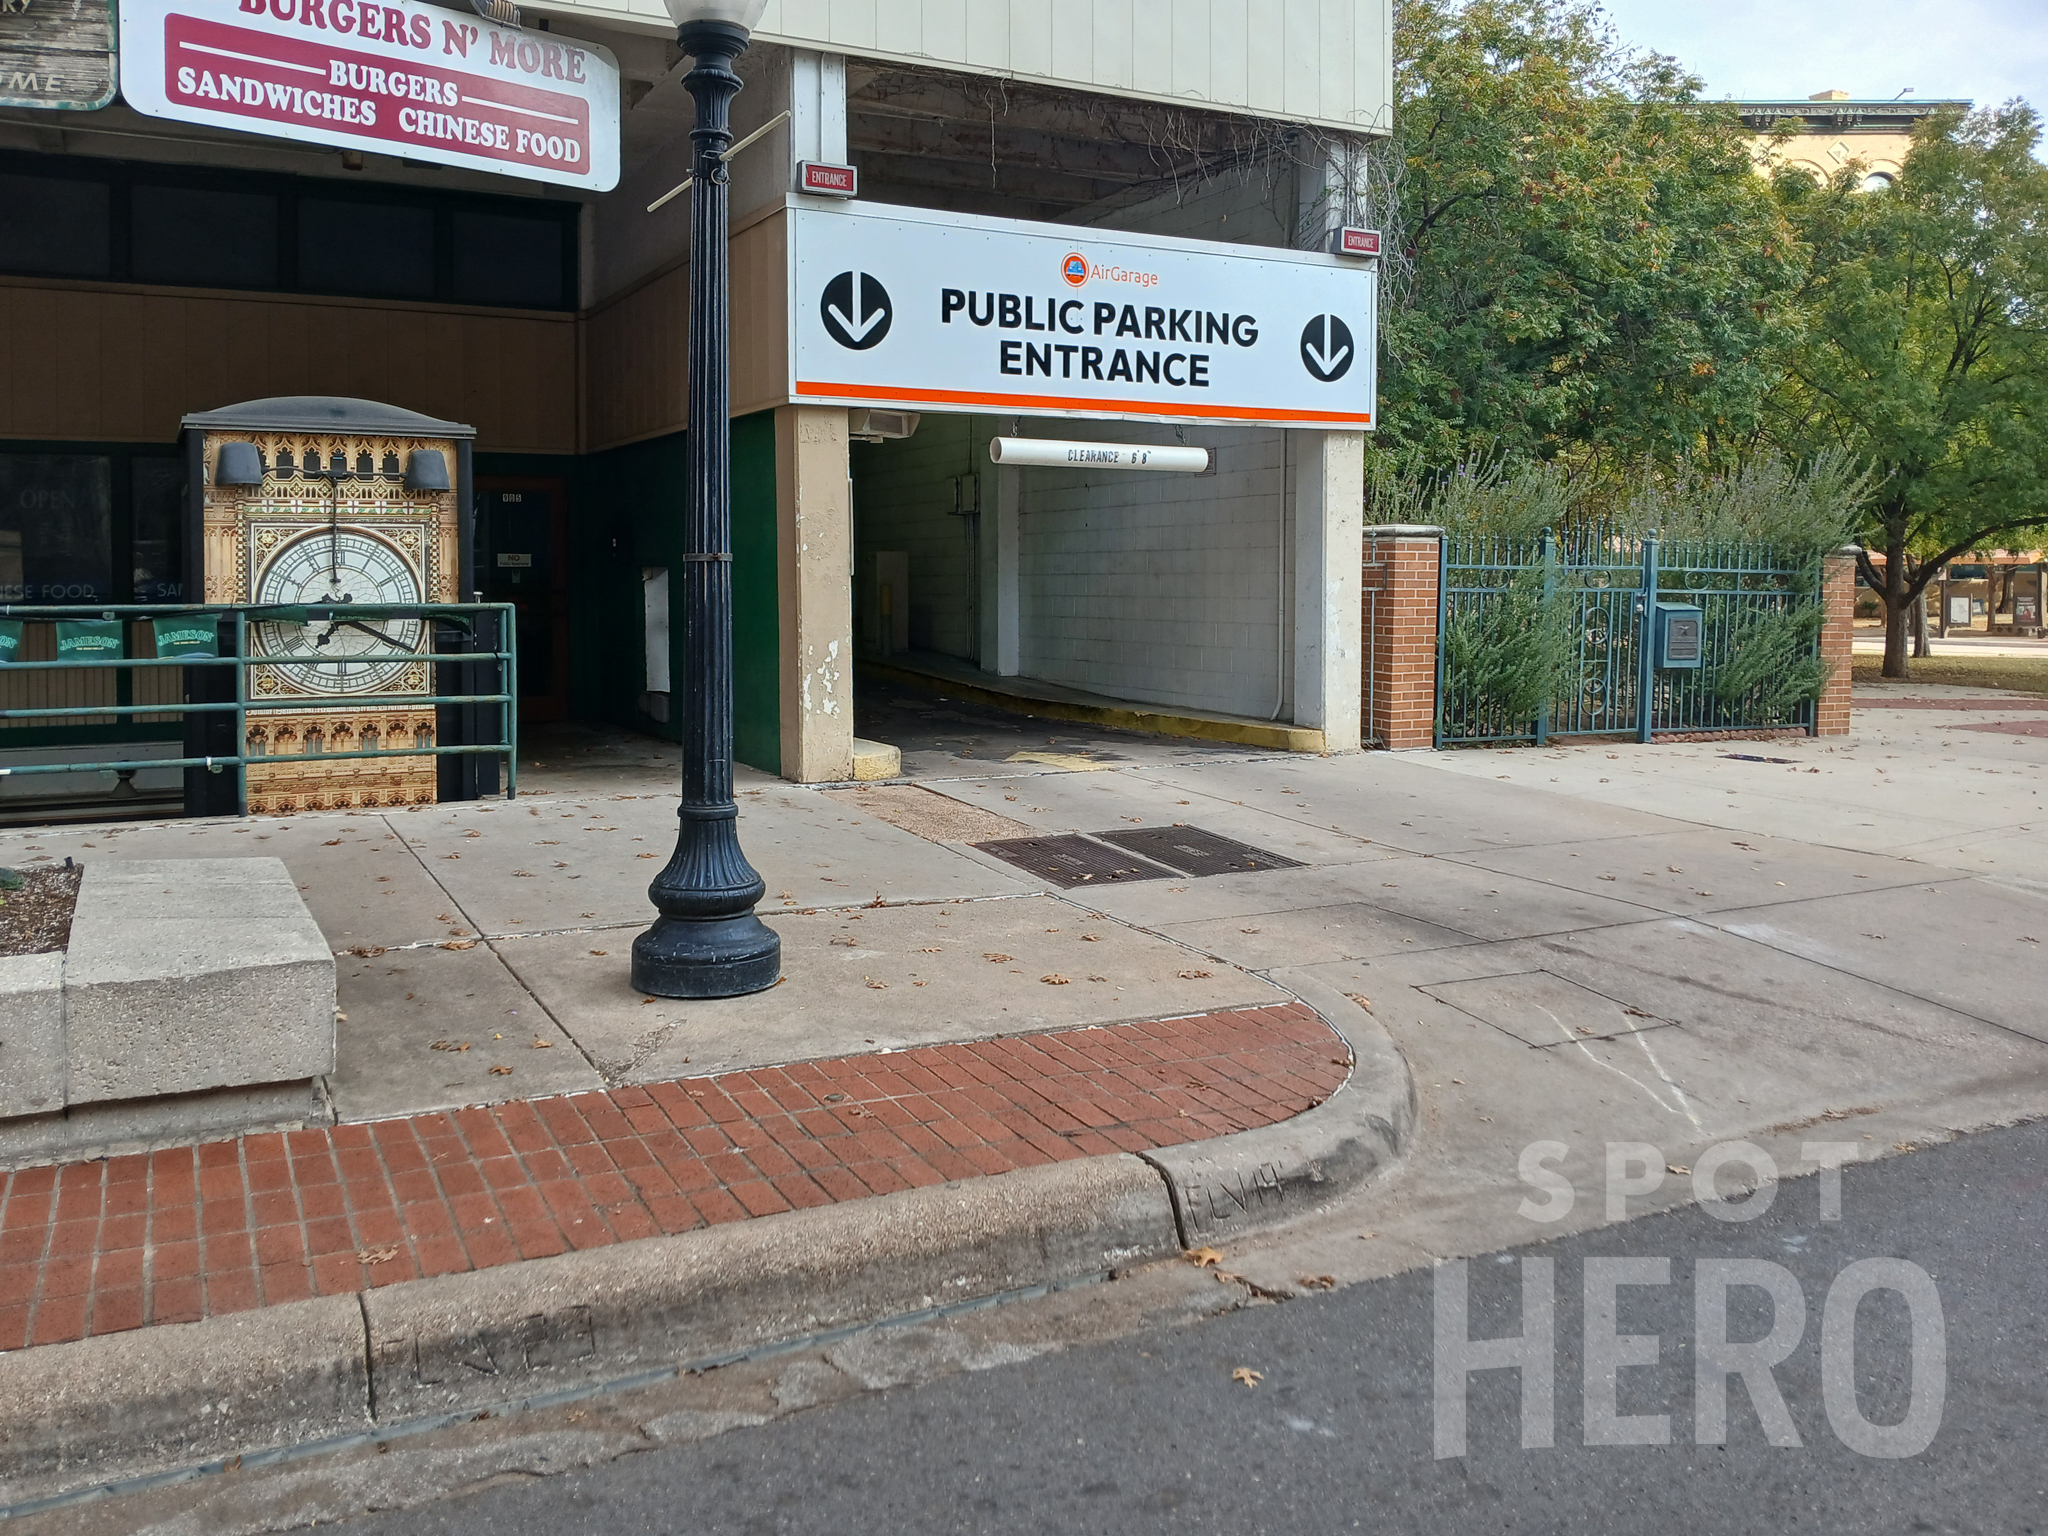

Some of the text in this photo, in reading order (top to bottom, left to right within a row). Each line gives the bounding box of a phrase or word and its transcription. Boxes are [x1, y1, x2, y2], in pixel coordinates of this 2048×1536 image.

[443, 20, 479, 58] N'
[489, 31, 586, 84] MORE
[0, 72, 64, 92] ME
[329, 60, 458, 106] BURGERS
[177, 66, 581, 163] SANDWICHES CHINESE FOOD
[811, 170, 848, 187] ENTRANCE
[1347, 235, 1375, 249] ENTRANCE
[1091, 264, 1159, 288] AirGarage
[941, 288, 1259, 347] PUBLIC PARKING
[1000, 340, 1210, 387] ENTRANCE
[1067, 449, 1120, 463] CLEARANCE
[507, 554, 520, 562] NO
[42, 584, 95, 599] FOOD
[60, 636, 120, 651] JAMESON
[158, 629, 215, 647] JAMESON
